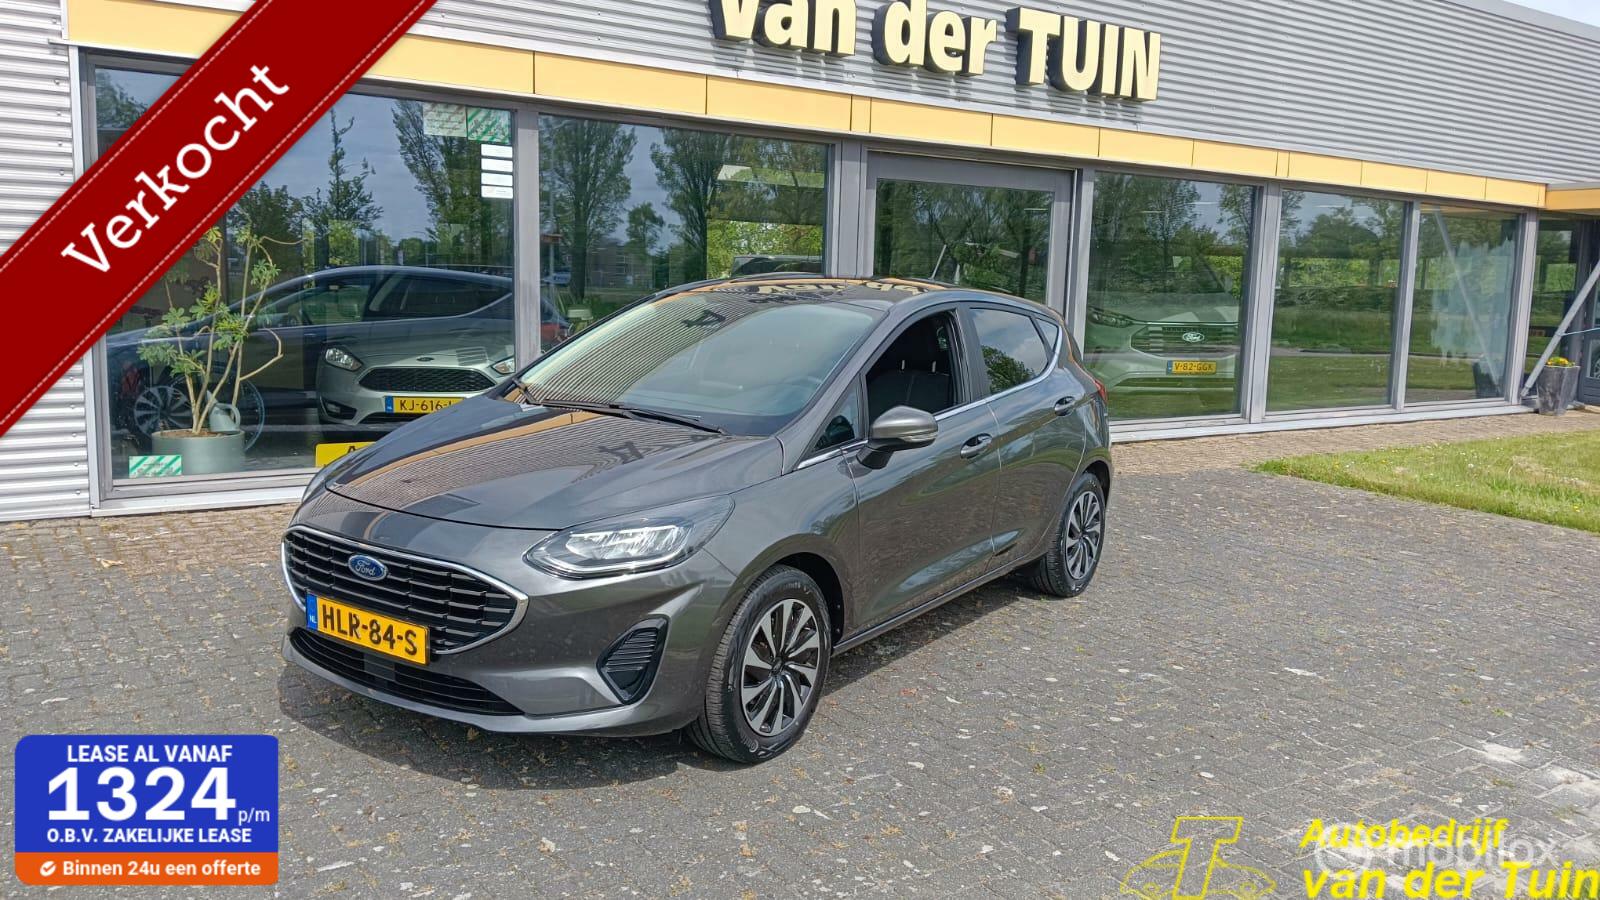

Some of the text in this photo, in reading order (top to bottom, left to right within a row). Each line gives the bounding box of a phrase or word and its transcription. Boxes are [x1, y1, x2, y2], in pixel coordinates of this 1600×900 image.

[716, 0, 1162, 101] van der TUIN
[352, 558, 380, 578] Ford
[322, 603, 418, 656] HLR-84-S
